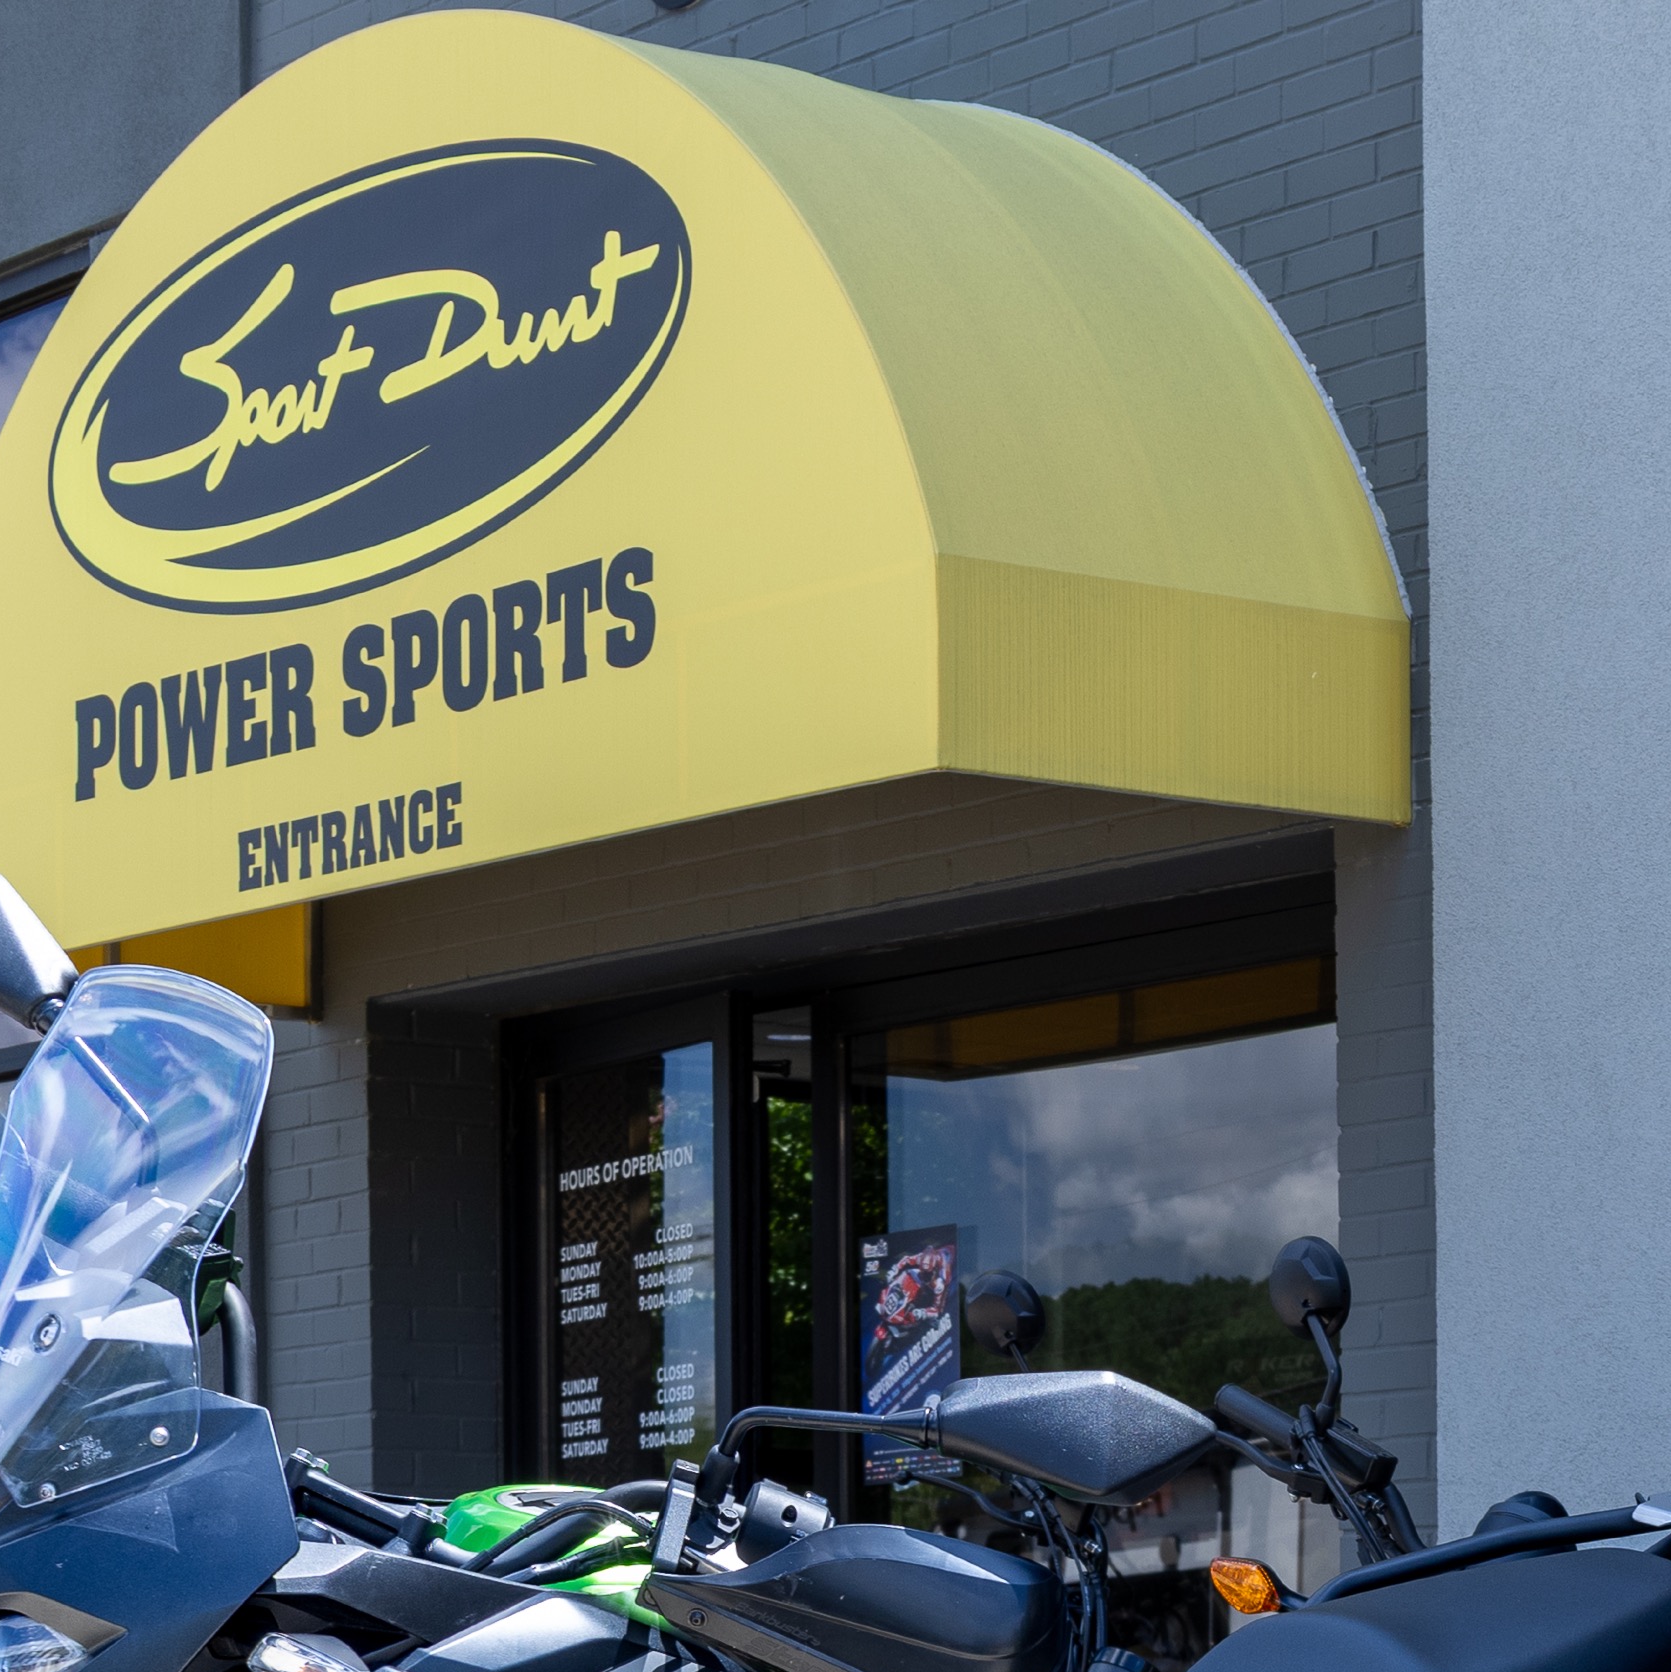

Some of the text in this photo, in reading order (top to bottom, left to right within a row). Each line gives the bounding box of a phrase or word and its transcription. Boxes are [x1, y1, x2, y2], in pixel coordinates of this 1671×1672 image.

[109, 230, 661, 492] Sport Durst
[74, 546, 657, 803] POWER SPORTS
[238, 780, 463, 893] ENTRANCE
[559, 1145, 694, 1192] HOURS OF OPERATION
[560, 1223, 694, 1262] SUNDAY CLOSED
[560, 1244, 694, 1283] MONDAY 10:00A-5:00P
[560, 1266, 694, 1304] TUES-FRI 9:00A-6:00P
[560, 1288, 694, 1325] SATURDAY 9:00A-4:00P
[561, 1363, 695, 1397] SUNDAY CLOSED
[561, 1385, 695, 1417] MONDAY CLOSED
[561, 1406, 695, 1438] TUES-FRI 9:00A-6:00P
[561, 1428, 695, 1459] SATURDAY 9:00A-4:00P
[734, 1601, 822, 1647] Barkbusters
